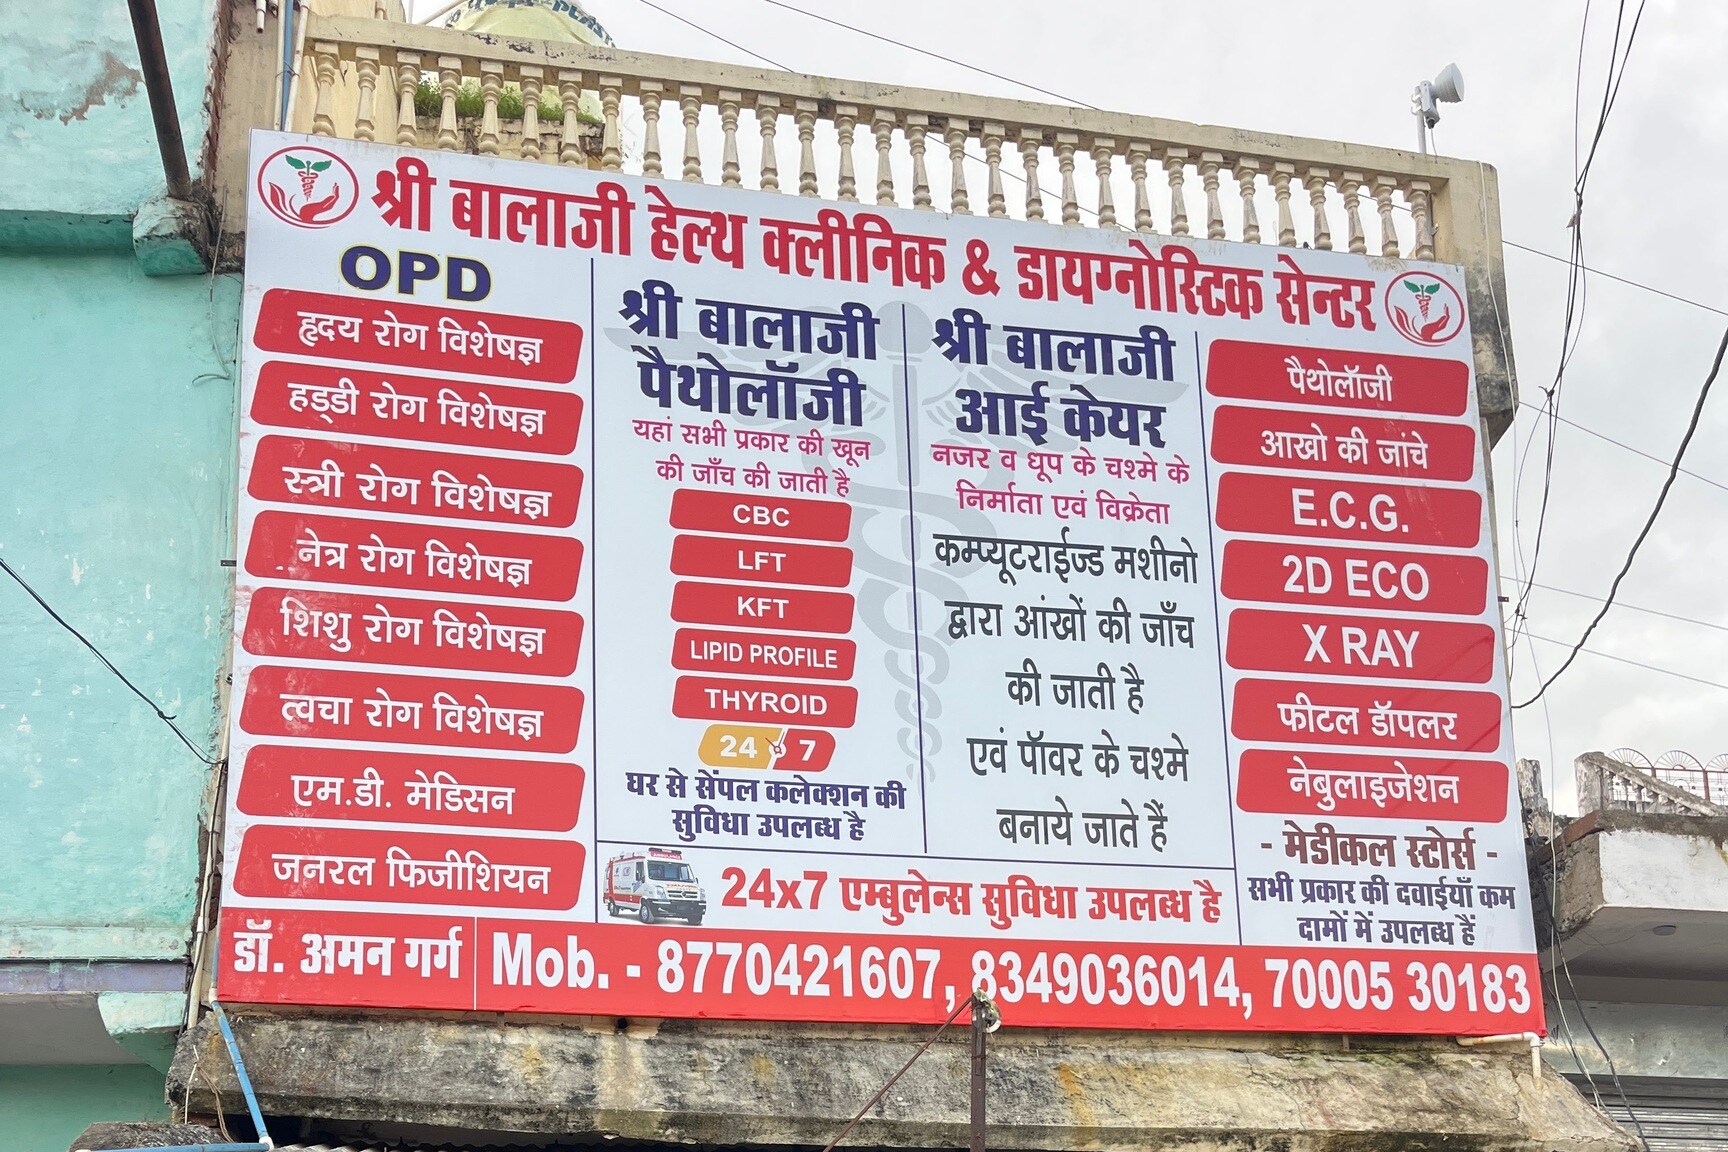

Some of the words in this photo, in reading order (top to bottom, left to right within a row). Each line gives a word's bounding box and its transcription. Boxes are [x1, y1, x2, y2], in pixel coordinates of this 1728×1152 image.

[371, 156, 437, 233] श्री
[449, 180, 636, 258] बालाजी
[645, 184, 748, 271] हेल्थ
[759, 208, 947, 292] क्लीनिक
[961, 237, 1001, 298] &
[1014, 238, 1264, 322] डायग्नोस्टिक
[1272, 253, 1377, 332] सेन्टर
[339, 244, 493, 303] OPD
[296, 309, 361, 347] हृदय
[374, 310, 428, 352] रोग
[437, 318, 545, 366] विशेषज्ञ
[617, 278, 683, 340] श्री
[695, 298, 881, 362] बालाजी
[931, 307, 992, 367] श्री
[1004, 325, 1177, 382] बालाजी
[630, 345, 868, 428] पैथोलॉजी
[1283, 356, 1394, 403] पैथोलॉजी
[369, 381, 429, 422] रोग
[436, 389, 546, 438] विशेषज्ञ
[955, 381, 1051, 446] आई
[1059, 386, 1168, 449] केयर
[633, 415, 672, 443] यहां
[681, 419, 728, 448] सभी
[733, 426, 792, 455] प्रकार
[796, 425, 826, 457] की
[831, 438, 871, 467] खून
[931, 443, 991, 468] नजर
[1000, 448, 1016, 469] व
[1026, 449, 1065, 484] धूप
[1073, 444, 1098, 476] के
[1102, 448, 1158, 480] चश्मे
[1166, 452, 1191, 484] के
[1260, 423, 1328, 463] आखो
[1335, 426, 1370, 466] की
[1377, 428, 1428, 470] जांचे
[282, 458, 345, 502] स्त्री
[356, 463, 421, 508] रोग
[430, 470, 554, 520] विशेषज्ञ
[655, 451, 685, 483] की
[691, 457, 735, 487] जाँच
[744, 457, 773, 490] की
[778, 464, 829, 494] जाती
[834, 468, 851, 498] है
[731, 505, 791, 528] CBC
[955, 478, 1045, 516] निर्माता
[1051, 488, 1088, 520] एवं
[1094, 489, 1171, 525] विक्रेता
[1291, 487, 1409, 533] E.C.G.
[296, 529, 350, 571] नेत्र
[360, 535, 414, 576] रोग
[424, 540, 533, 587] विशेषज्ञ
[737, 549, 786, 573] LFT
[1114, 535, 1199, 585] मशीनो
[1282, 554, 1333, 595] 2D
[1344, 558, 1430, 601] ECO
[280, 596, 353, 653] शिशु
[365, 607, 421, 648] रोग
[432, 609, 546, 658] विशेषज्ञ
[736, 596, 789, 620] KFT
[944, 600, 1002, 640] द्वारा
[1014, 596, 1087, 642] आंखों
[1096, 597, 1133, 646] की
[1140, 601, 1196, 649] जाँच
[689, 640, 743, 664] LIPID
[748, 644, 839, 670] PROFILE
[1302, 623, 1333, 663] X
[1342, 625, 1421, 667] RAY
[703, 688, 829, 716] THYROID
[1006, 658, 1041, 708] की
[1051, 662, 1116, 711] जाती
[1120, 663, 1145, 714] है
[280, 692, 352, 728] त्वचा
[366, 687, 421, 731] रोग
[431, 695, 545, 740] विशेषज्ञ
[1277, 691, 1360, 735] फीटल
[1367, 698, 1458, 741] डॉपलर
[719, 735, 758, 759] 24
[799, 739, 816, 762] 7
[968, 726, 1008, 776] एवं
[1017, 732, 1083, 778] पॉवर
[1092, 730, 1120, 781] के
[1128, 733, 1190, 783] चश्मे
[291, 768, 393, 810] एम.डी.
[403, 769, 517, 816] मेडिसन
[625, 770, 662, 798] घर
[668, 768, 687, 801] से
[694, 769, 760, 802] सेंपल
[764, 774, 870, 808] कलेक्शन
[874, 779, 908, 812] की
[1286, 756, 1460, 813] नेबुलाइजेशन
[671, 808, 750, 843] सुविधा
[756, 814, 842, 840] उपलब्ध
[842, 810, 867, 841] है
[996, 796, 1073, 847] बनाये
[1085, 798, 1139, 850] जाते
[1282, 820, 1396, 867] मेडीकल
[1404, 826, 1475, 870] स्टोर्स
[272, 852, 374, 891] जनरल
[385, 845, 552, 896] फिजीशियन
[1247, 871, 1294, 902] सभी
[1299, 878, 1356, 904] प्रकार
[1359, 874, 1389, 905] की
[1477, 885, 1515, 909] कम
[721, 866, 829, 911] 24x7
[839, 868, 972, 926] एम्बुलेन्स
[980, 874, 1078, 929] सुविधा
[1085, 886, 1192, 923] उपलब्ध
[1193, 879, 1223, 924] है
[232, 920, 283, 976] डॉ.
[300, 932, 396, 978] अमन
[404, 925, 464, 980] गर्ग
[1297, 910, 1348, 942] दामों
[1354, 911, 1374, 943] में
[1379, 919, 1454, 945] उपलब्ध
[492, 930, 610, 991] Mob.
[656, 938, 956, 1012] 8770421607,
[970, 949, 1253, 1020] 8349036014,
[1265, 957, 1394, 1011] 70005
[1405, 961, 1532, 1014] 30183
